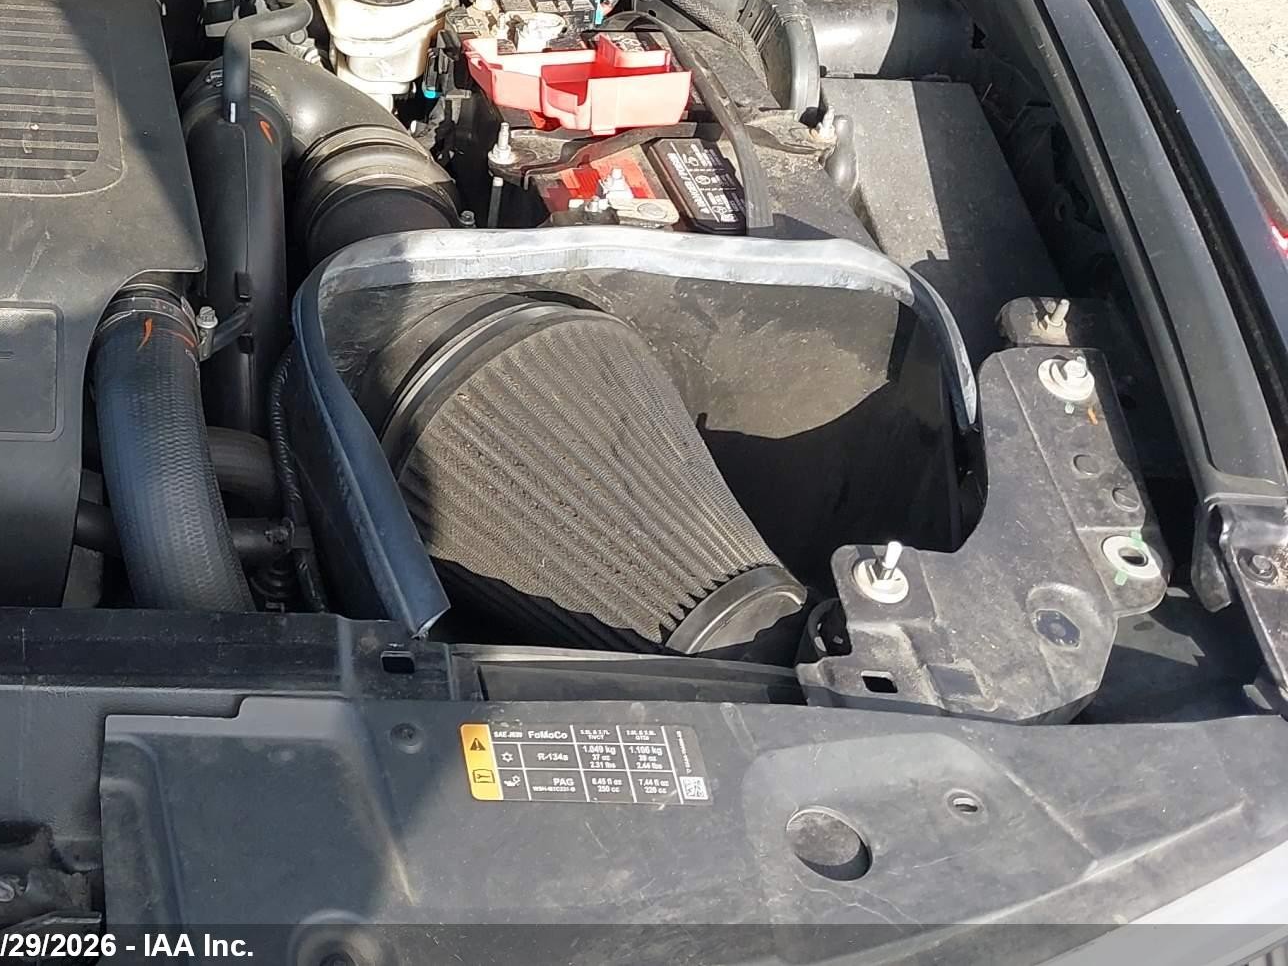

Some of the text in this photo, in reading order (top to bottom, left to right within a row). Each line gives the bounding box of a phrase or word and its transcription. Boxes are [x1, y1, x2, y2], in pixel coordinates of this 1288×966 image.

[527, 730, 568, 739] FoMoCo
[605, 746, 616, 755] kg
[652, 746, 663, 756] kg
[552, 777, 575, 786] PAG
